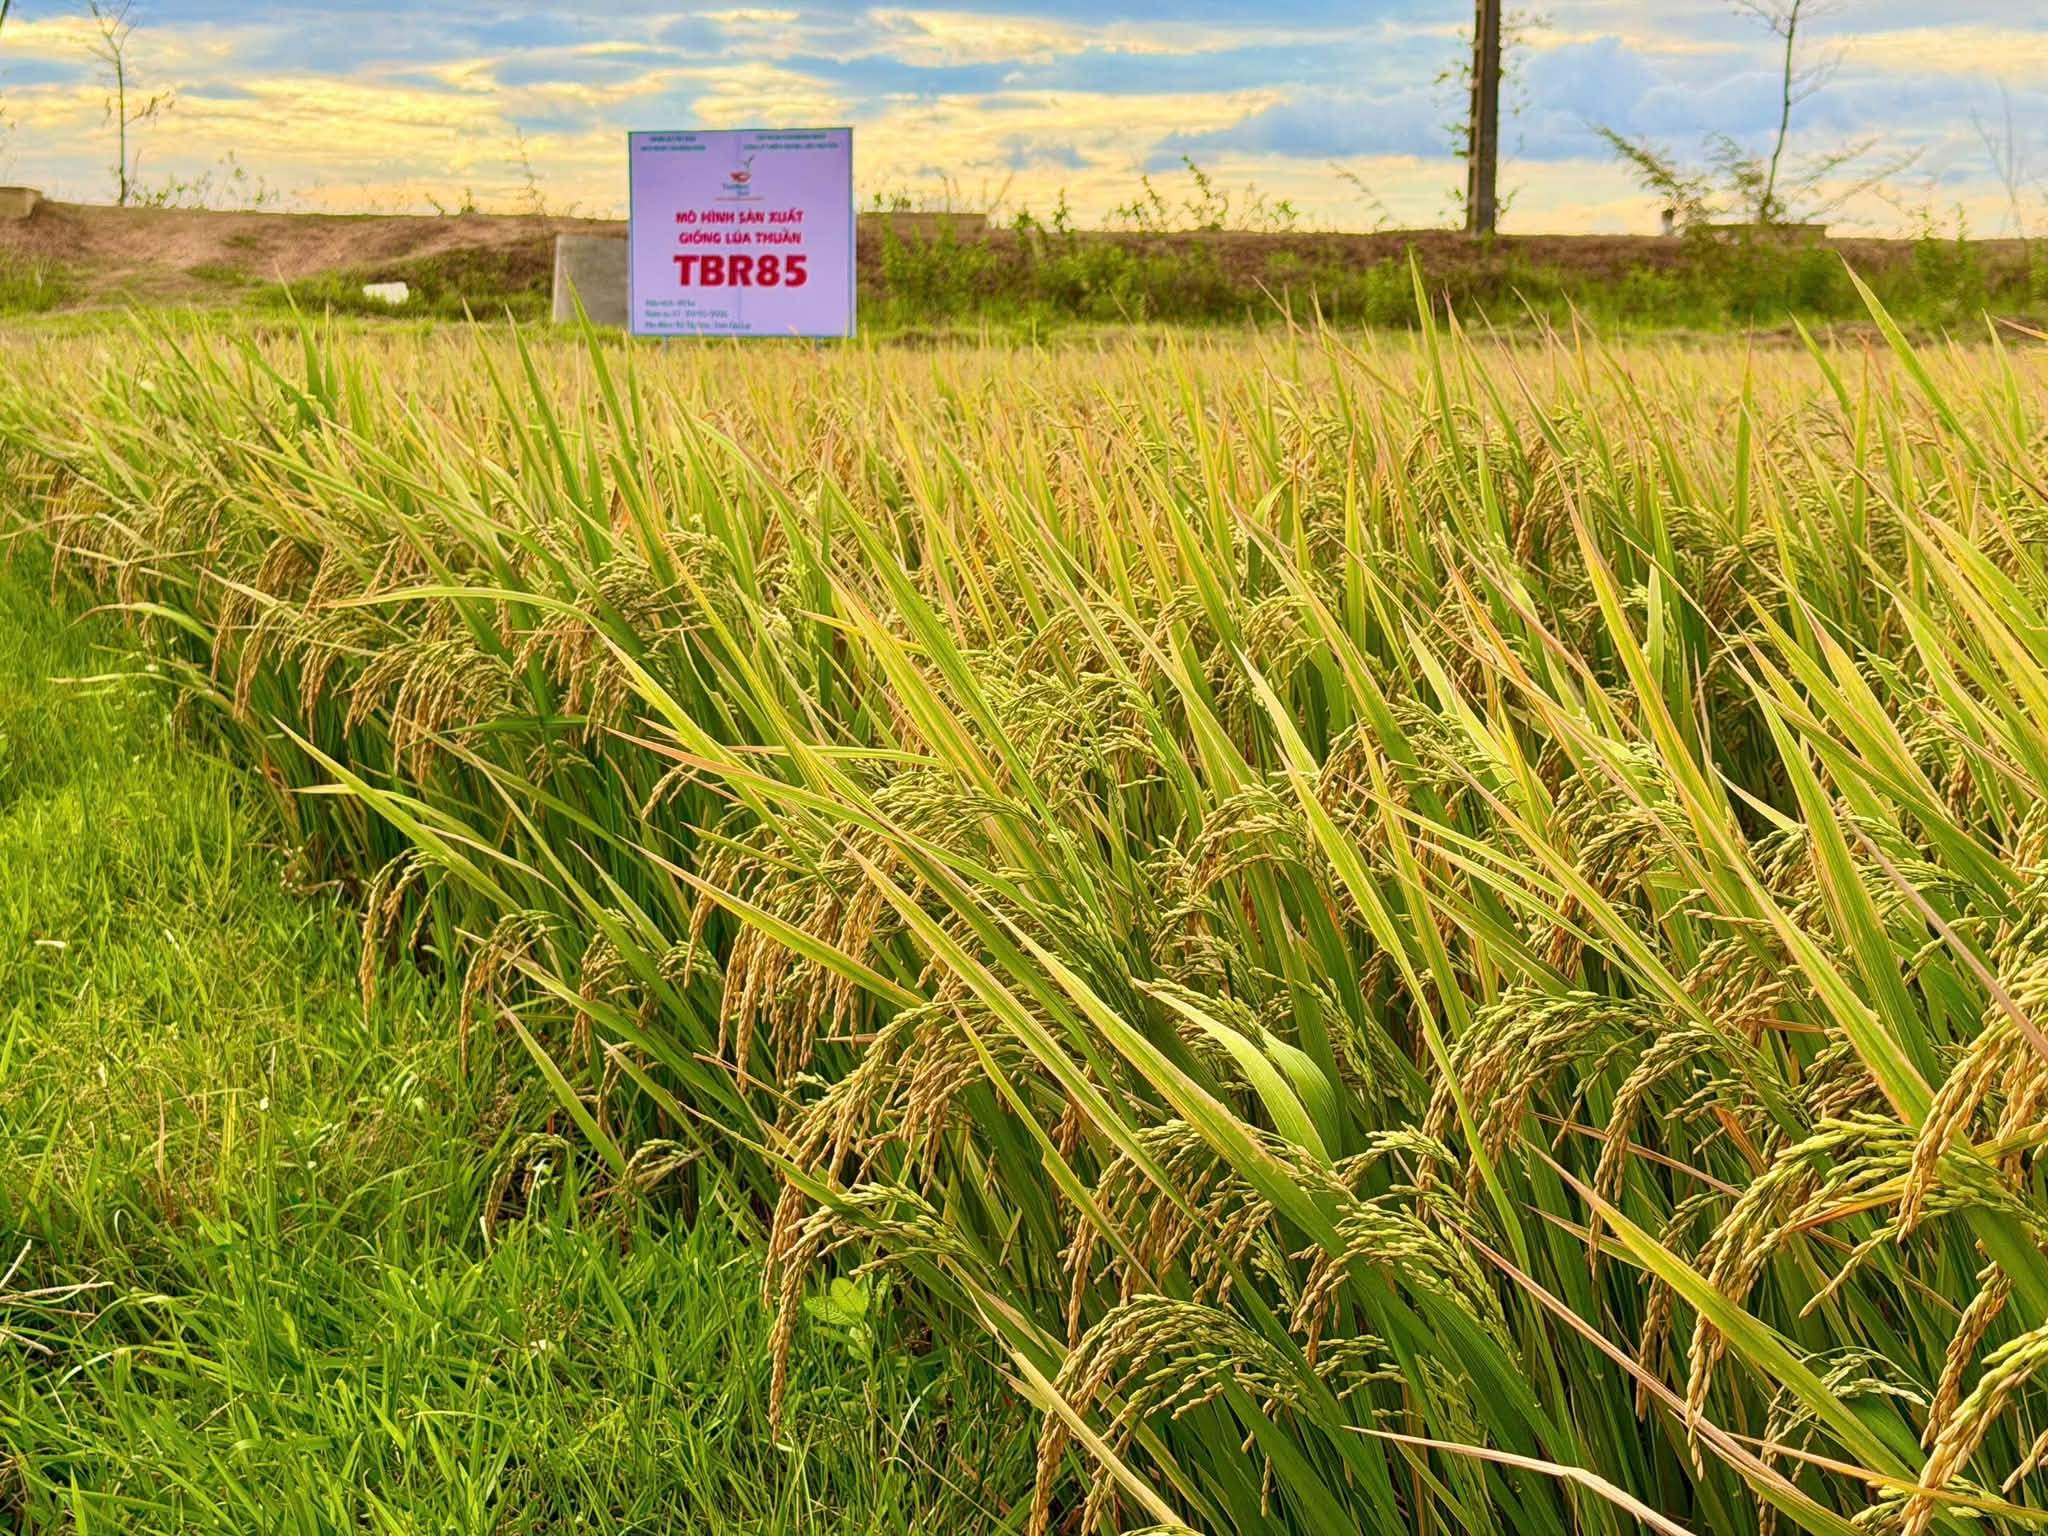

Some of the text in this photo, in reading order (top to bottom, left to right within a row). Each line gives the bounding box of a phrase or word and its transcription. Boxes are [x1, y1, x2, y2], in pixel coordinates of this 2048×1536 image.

[676, 210, 697, 224] MÔ
[701, 208, 735, 224] HÌNH
[769, 207, 804, 224] XUẤT
[679, 229, 722, 245] GIỐNG
[726, 229, 751, 244] LÚA
[673, 254, 808, 287] TBR85
